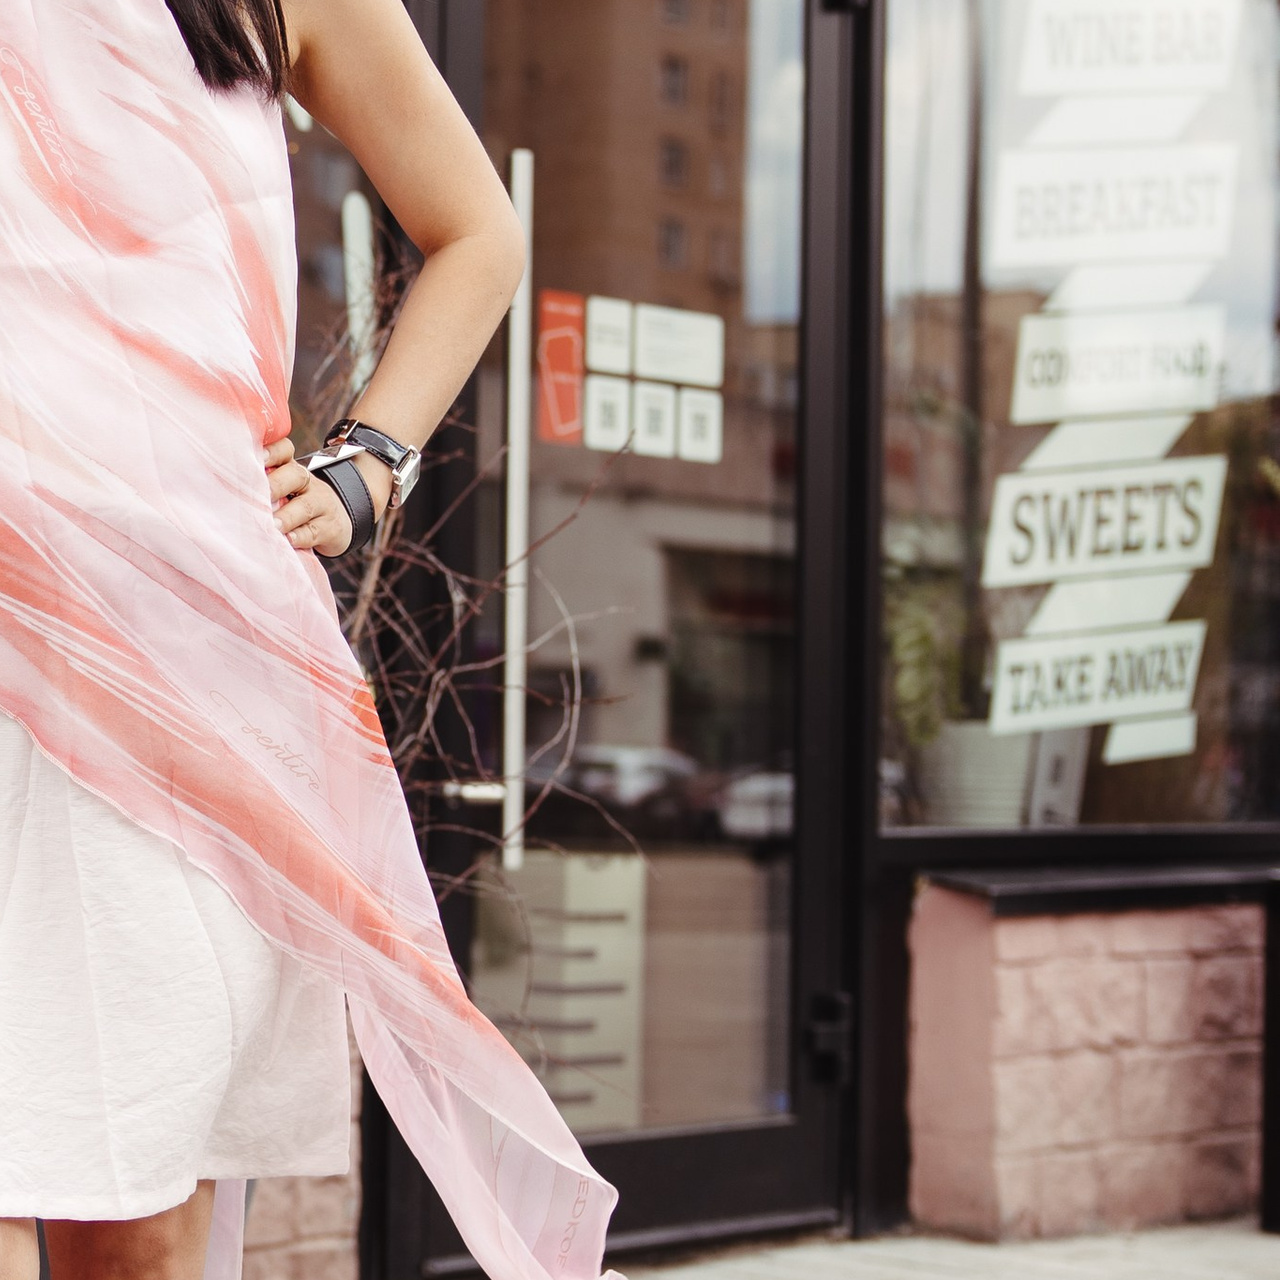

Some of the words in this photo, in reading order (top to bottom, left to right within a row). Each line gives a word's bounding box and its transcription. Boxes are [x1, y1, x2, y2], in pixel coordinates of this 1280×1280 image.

[1044, 9, 1144, 70] WINE
[1152, 7, 1224, 65] BAR
[1014, 172, 1222, 242] BREAKFAST
[1009, 478, 1205, 567] SWEETS
[1007, 653, 1094, 715] TAKE
[1102, 640, 1193, 700] AWAY
